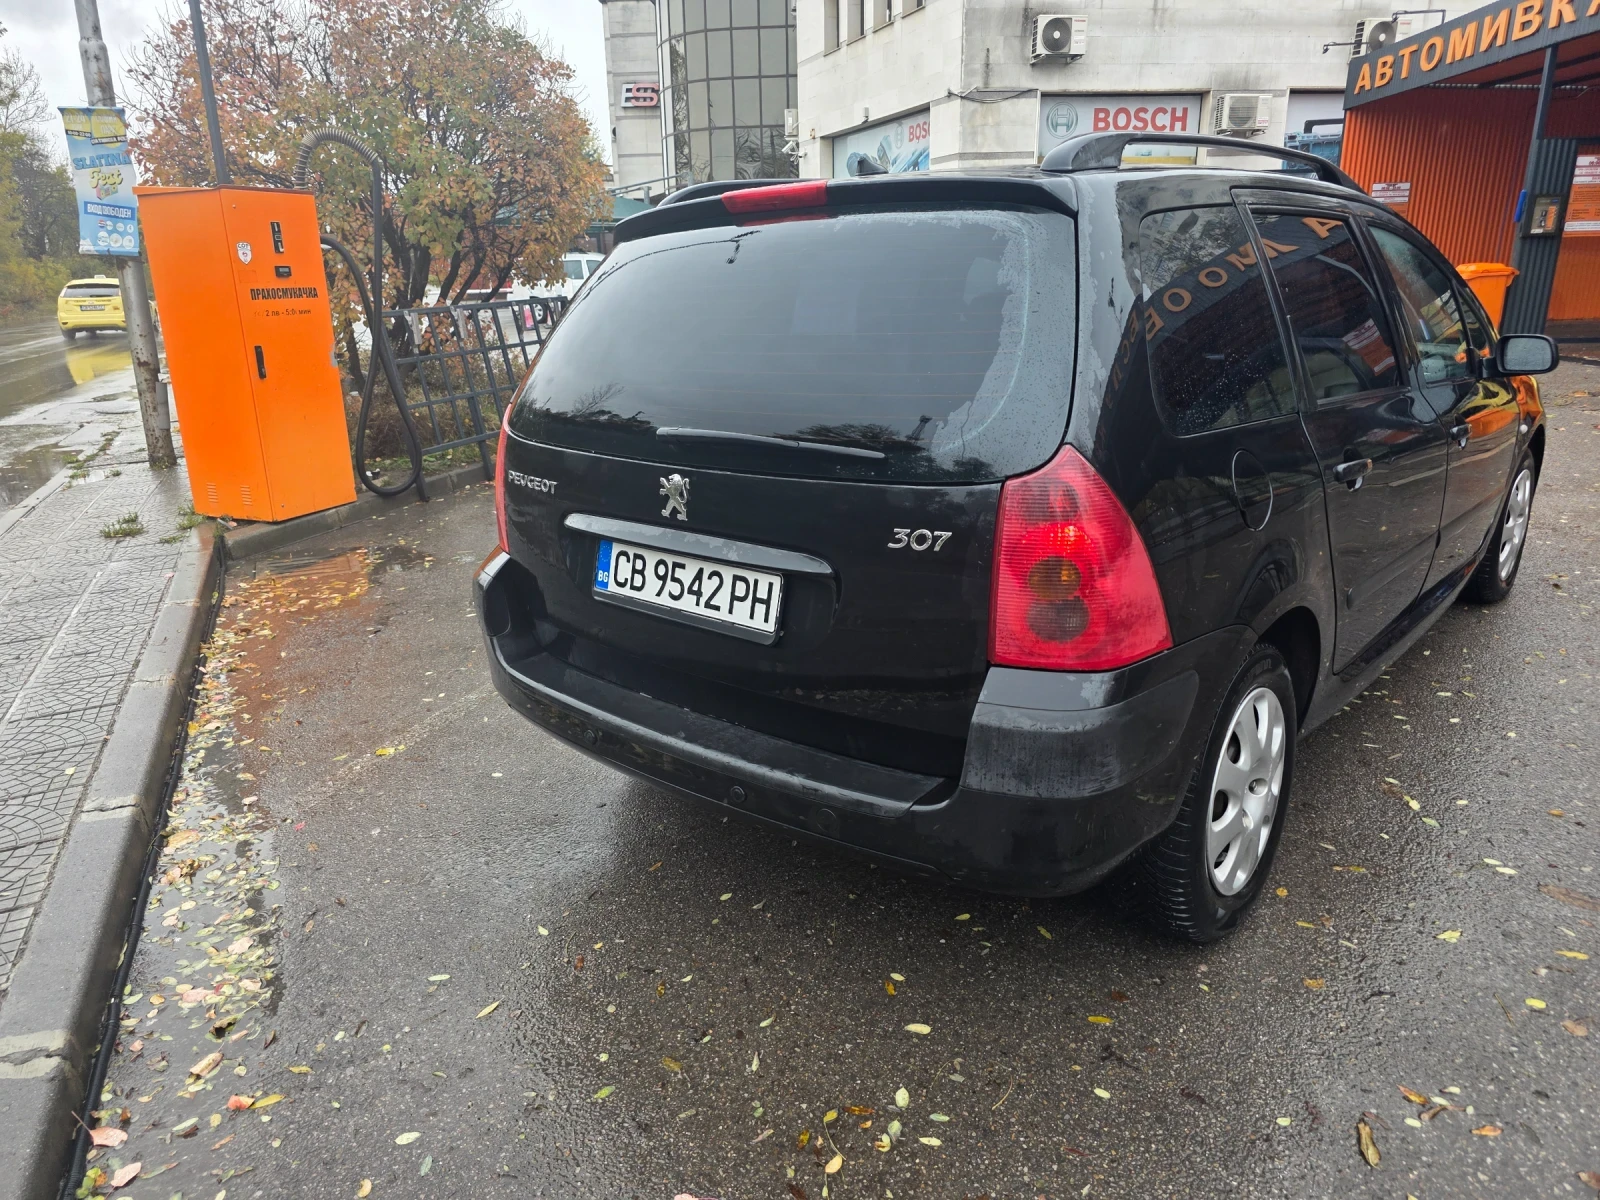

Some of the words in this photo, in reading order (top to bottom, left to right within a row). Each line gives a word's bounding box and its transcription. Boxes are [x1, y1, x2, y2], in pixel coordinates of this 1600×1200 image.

[1354, 0, 1600, 95] АВТОМИВК
[1092, 106, 1189, 132] BOSCH
[908, 121, 930, 142] BOS
[73, 153, 132, 170] SLATINA
[88, 166, 123, 189] Fest
[250, 287, 318, 301] ПРАХОСМУКАЧКА
[508, 470, 558, 495] PEUGEOT
[887, 528, 953, 552] 307
[597, 570, 609, 583] BG
[613, 550, 647, 592] CB
[653, 558, 724, 612] 9542
[728, 574, 774, 624] PH
